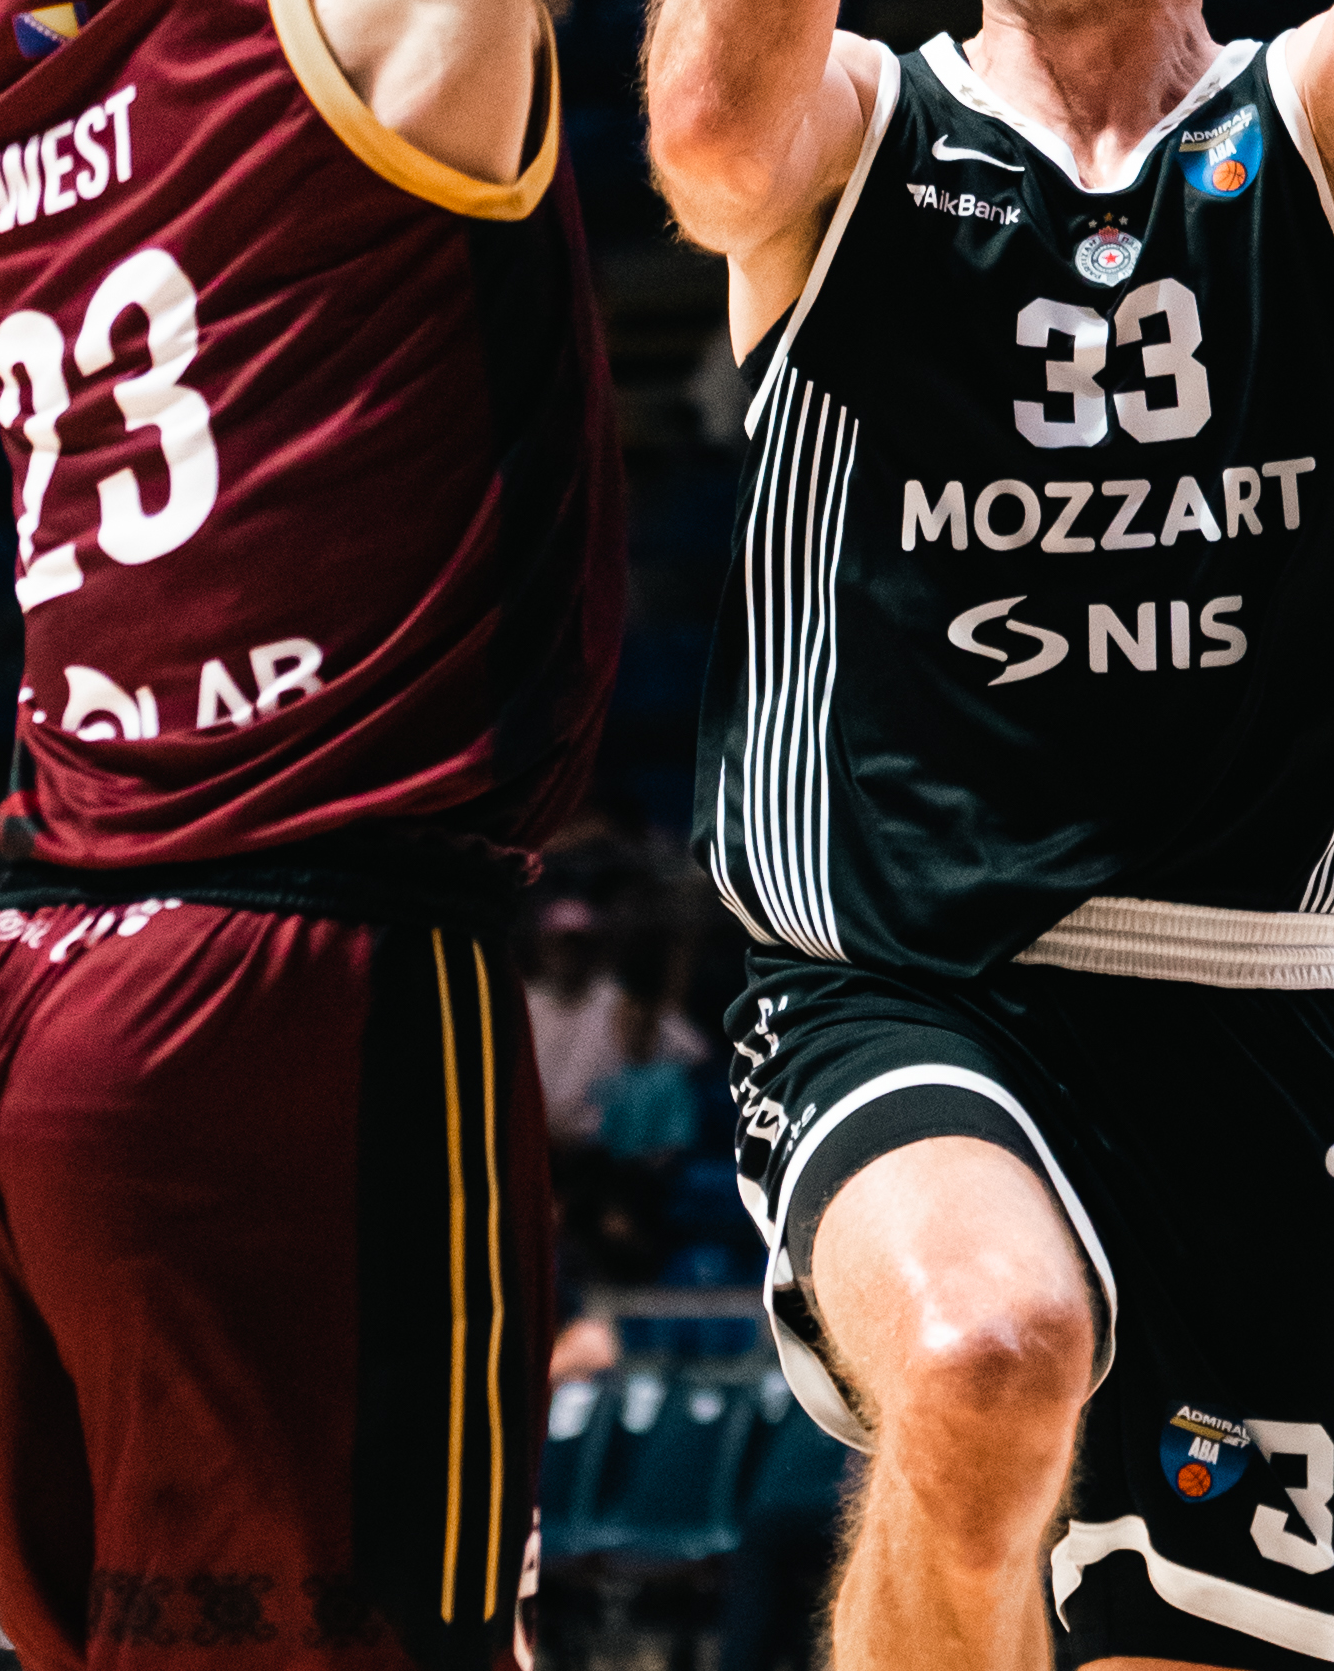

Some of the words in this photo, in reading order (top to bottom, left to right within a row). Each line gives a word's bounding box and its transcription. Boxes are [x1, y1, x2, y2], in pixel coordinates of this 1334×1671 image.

[1208, 137, 1237, 167] ABA
[923, 184, 1021, 225] AikBank
[1013, 278, 1212, 449] 33
[902, 456, 1316, 554] MOZZART
[1088, 595, 1248, 673] NIS
[1176, 1405, 1251, 1440] ADMIRAL
[1188, 1436, 1220, 1466] ABA
